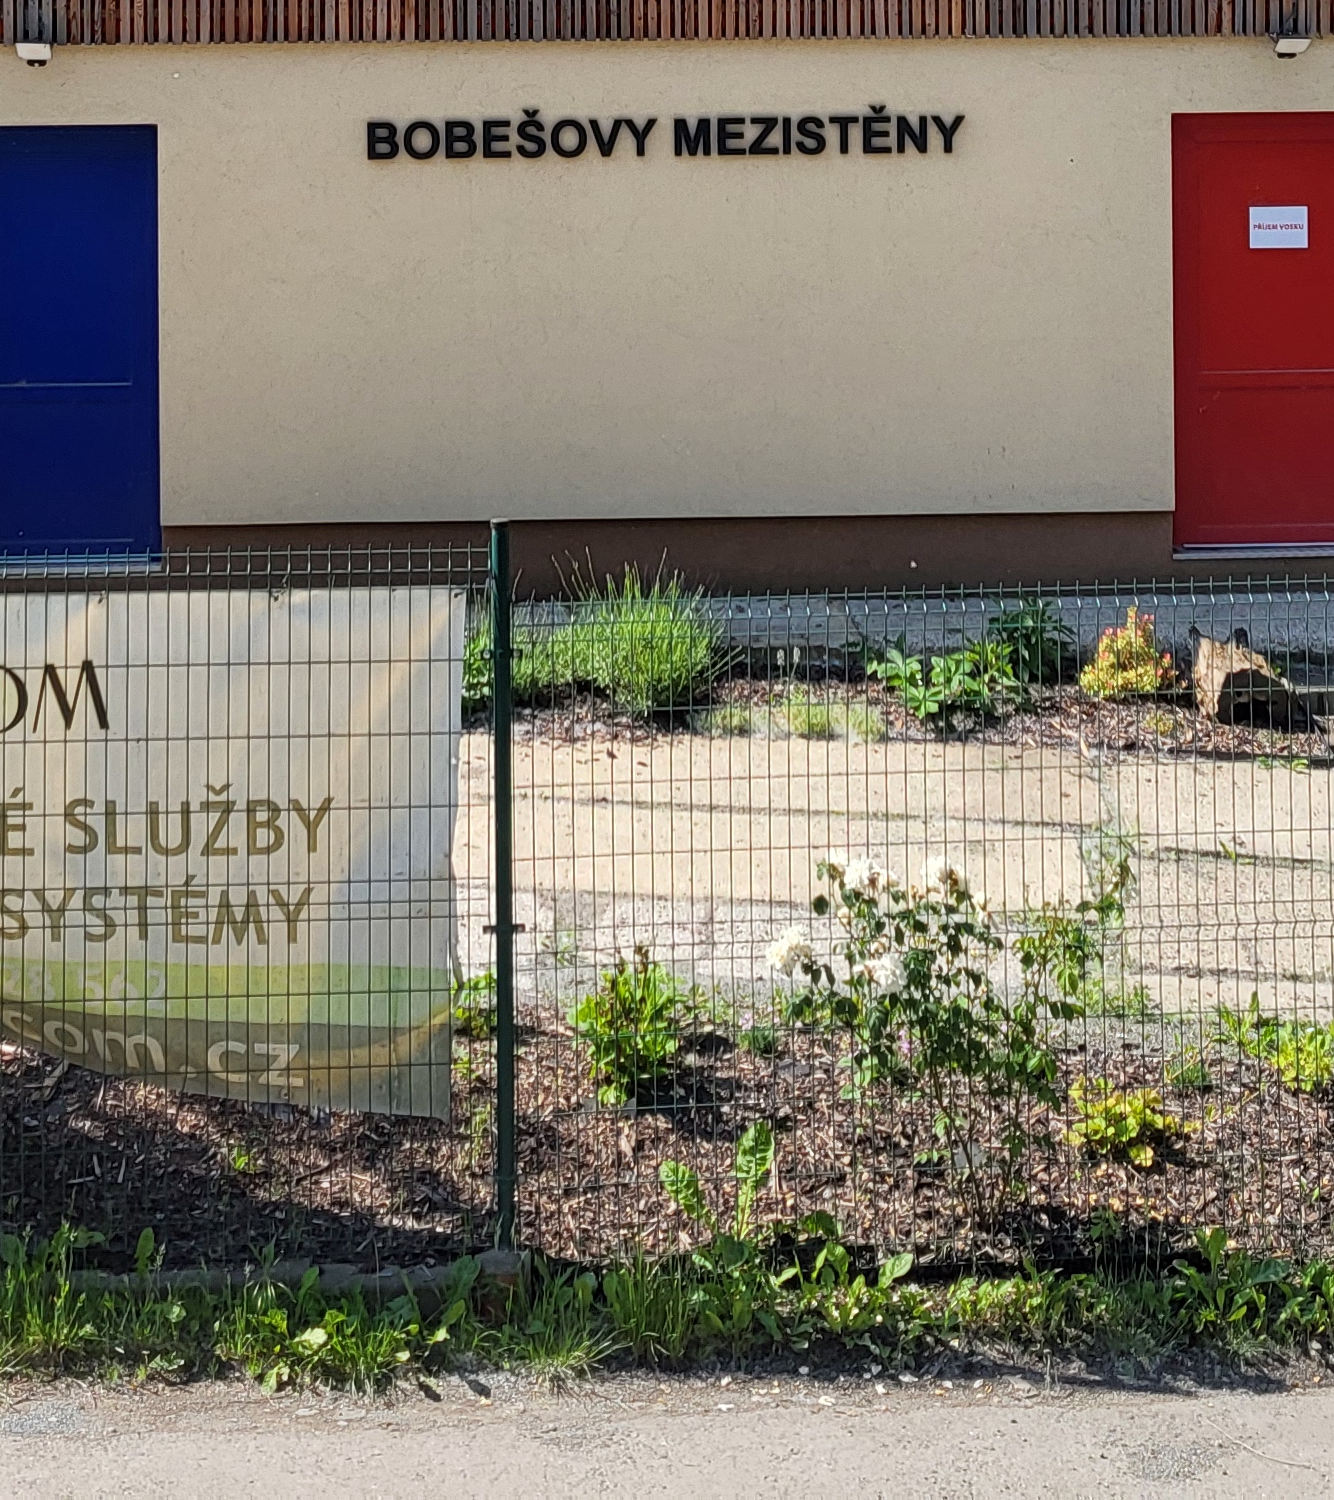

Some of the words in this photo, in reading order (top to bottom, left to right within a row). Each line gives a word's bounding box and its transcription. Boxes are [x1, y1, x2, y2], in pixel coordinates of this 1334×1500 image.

[366, 109, 658, 160] BOBEŠOVY
[674, 105, 965, 156] MEZISTĚNY
[1253, 222, 1278, 230] PŘÍJEM
[66, 782, 336, 857] SLUŽBY
